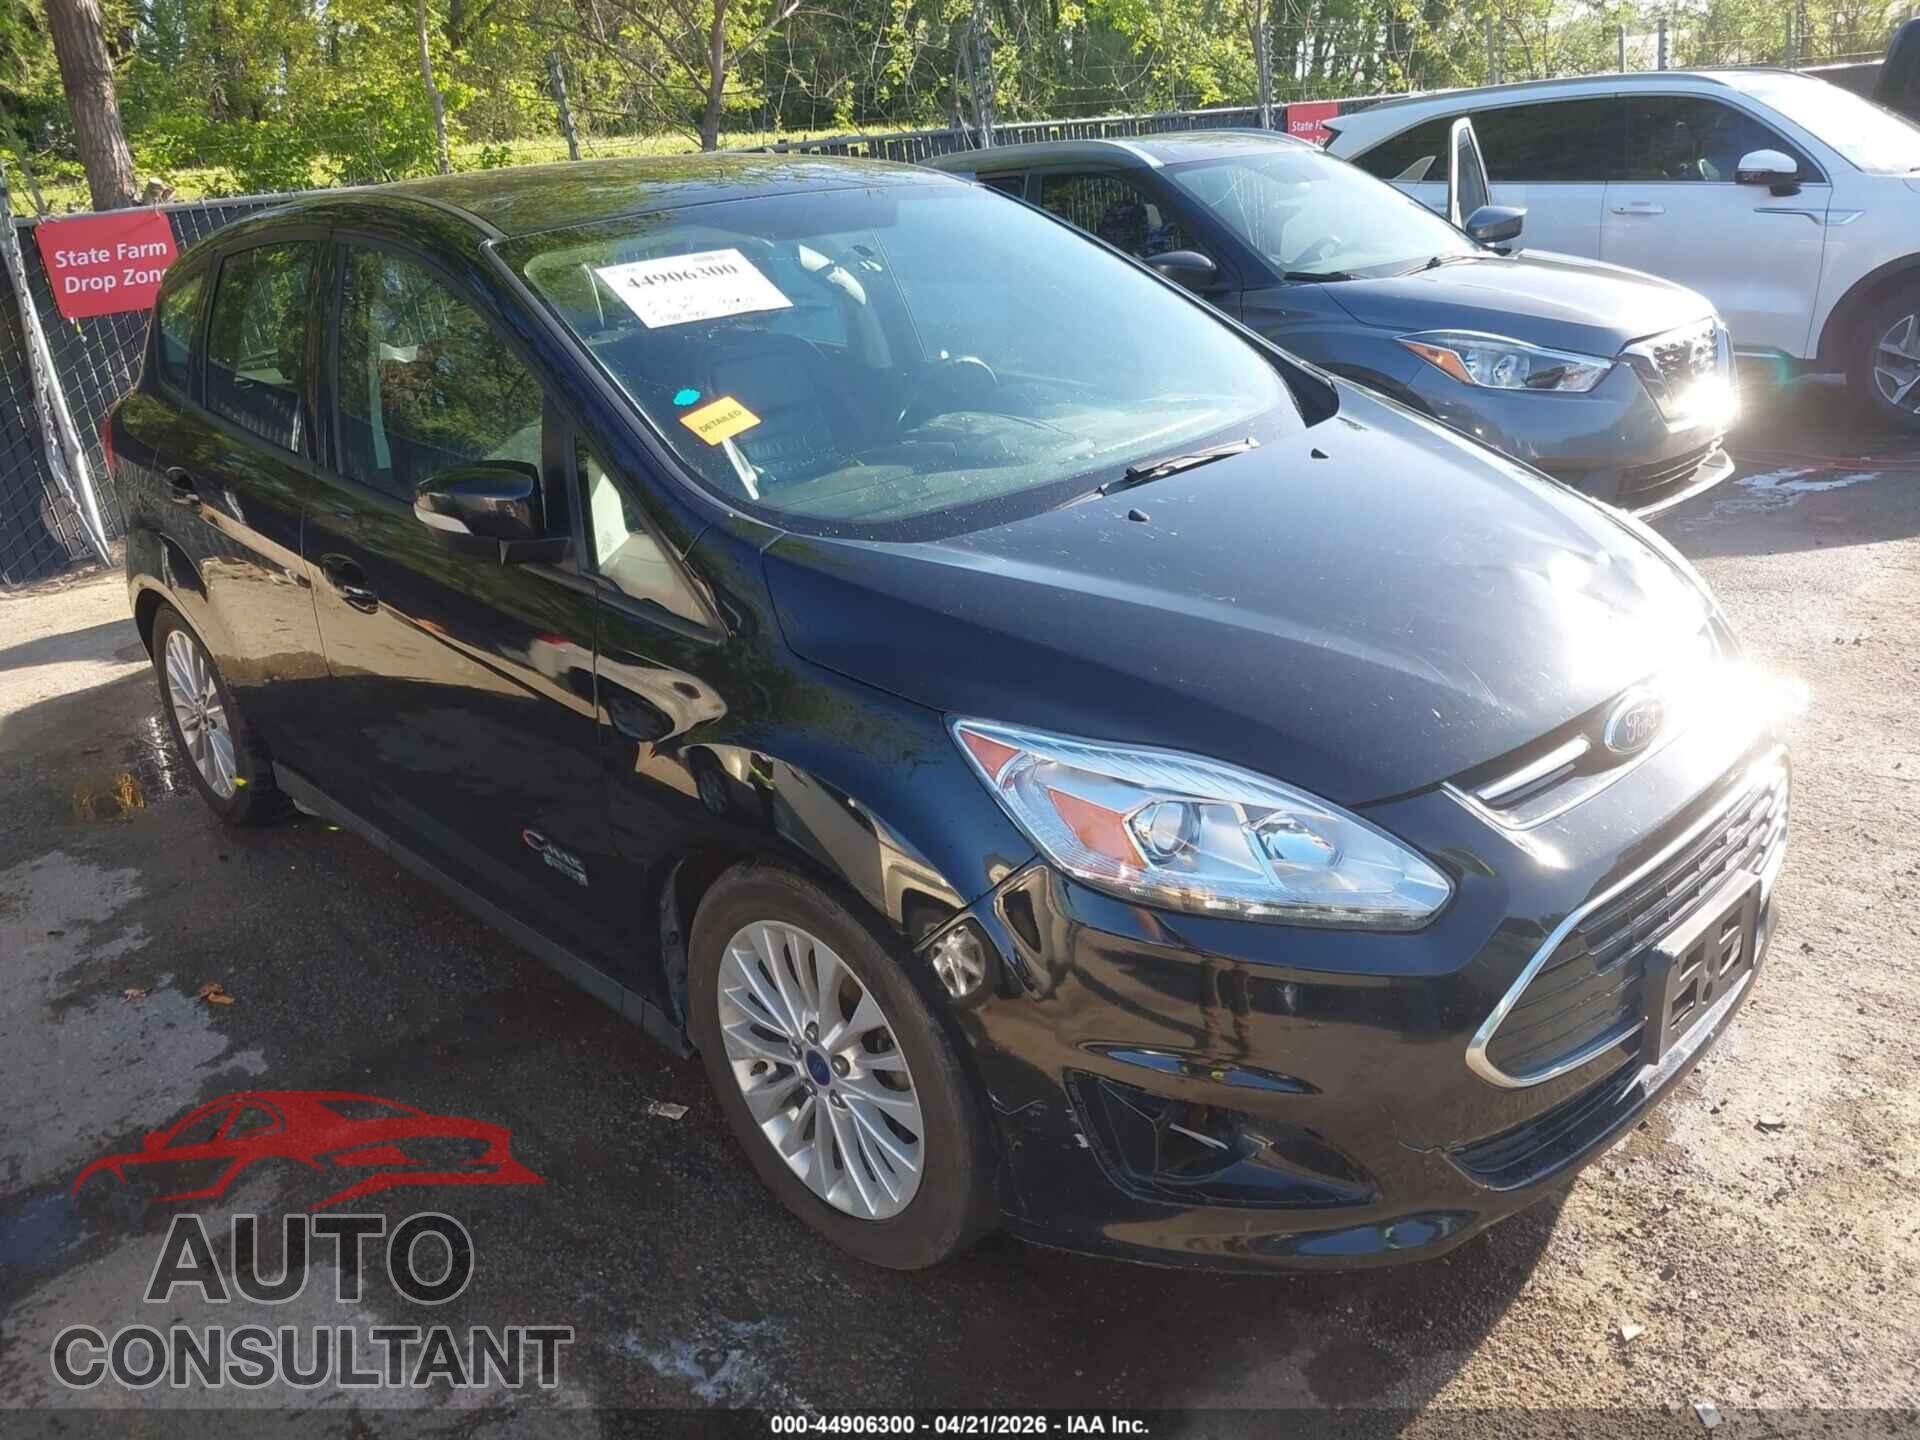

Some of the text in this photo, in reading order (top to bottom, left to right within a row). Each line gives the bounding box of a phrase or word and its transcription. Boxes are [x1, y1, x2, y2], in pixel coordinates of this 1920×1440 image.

[1291, 121, 1313, 132] State
[55, 241, 168, 269] State Farm
[64, 275, 117, 295] Drop
[626, 262, 739, 289] 44906300
[698, 409, 742, 433] DETAILED
